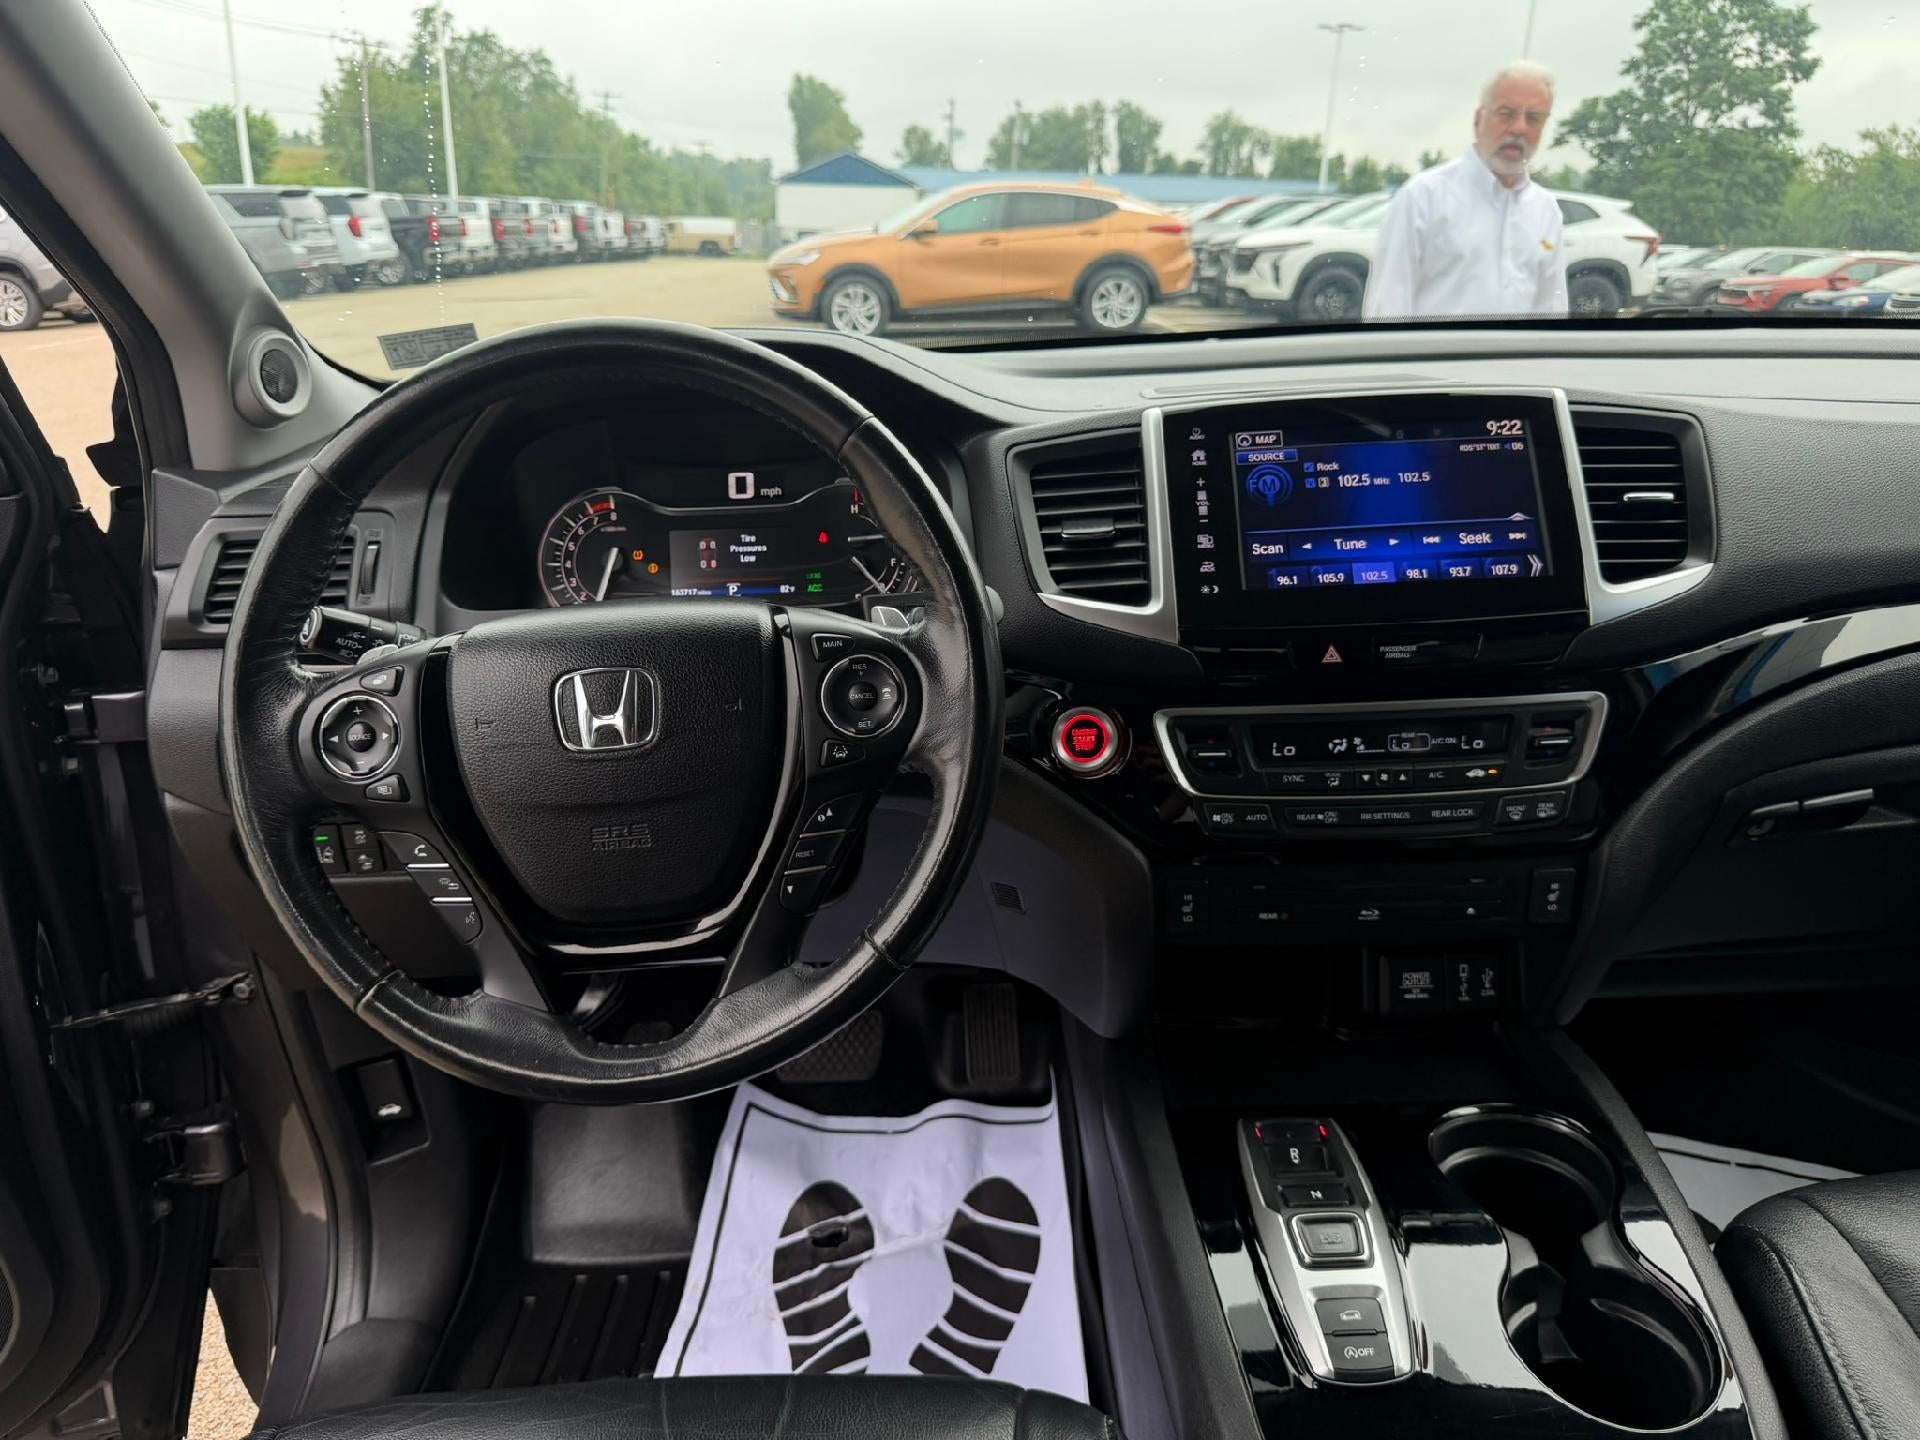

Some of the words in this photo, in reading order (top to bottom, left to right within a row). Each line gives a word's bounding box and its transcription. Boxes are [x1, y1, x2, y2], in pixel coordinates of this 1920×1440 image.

[1486, 420, 1524, 436] 9:22
[1255, 435, 1277, 445] MAP
[1248, 452, 1285, 463] SOURCE
[1316, 462, 1339, 472] Rock
[1338, 473, 1371, 488] 102.5
[1373, 477, 1391, 486] MHz
[1398, 471, 1431, 483] 102.5
[760, 486, 783, 499] mph
[593, 516, 599, 526] 7
[610, 512, 618, 521] 8
[741, 534, 757, 543] Tire
[1458, 532, 1492, 545] Seek
[567, 542, 576, 552] 5
[1252, 543, 1285, 556] Scan
[1333, 538, 1368, 551] Tune
[740, 554, 757, 563] Low
[564, 560, 572, 569] 4
[1406, 568, 1429, 580] 98.1
[1449, 566, 1473, 578] 93.7
[1490, 564, 1519, 576] 107.9
[1276, 575, 1299, 586] 96.1
[1317, 572, 1345, 584] 105.9
[1361, 570, 1389, 582] 102.5
[569, 577, 577, 588] 3
[335, 637, 358, 649] AUTO
[822, 640, 843, 649] MAIN
[857, 720, 872, 729] SET
[1072, 735, 1096, 743] START
[1461, 735, 1485, 750] Lo
[1271, 742, 1296, 757] Lo
[1282, 774, 1305, 784] SYNC
[1428, 771, 1446, 780] A/C
[1246, 813, 1268, 822] AUTO
[1374, 811, 1411, 820] SETTINGS
[1431, 809, 1452, 818] REAR
[1453, 807, 1474, 817] LOCK
[1258, 912, 1279, 920] REAR
[1310, 1190, 1323, 1199] N
[1357, 1347, 1374, 1357] OFF
